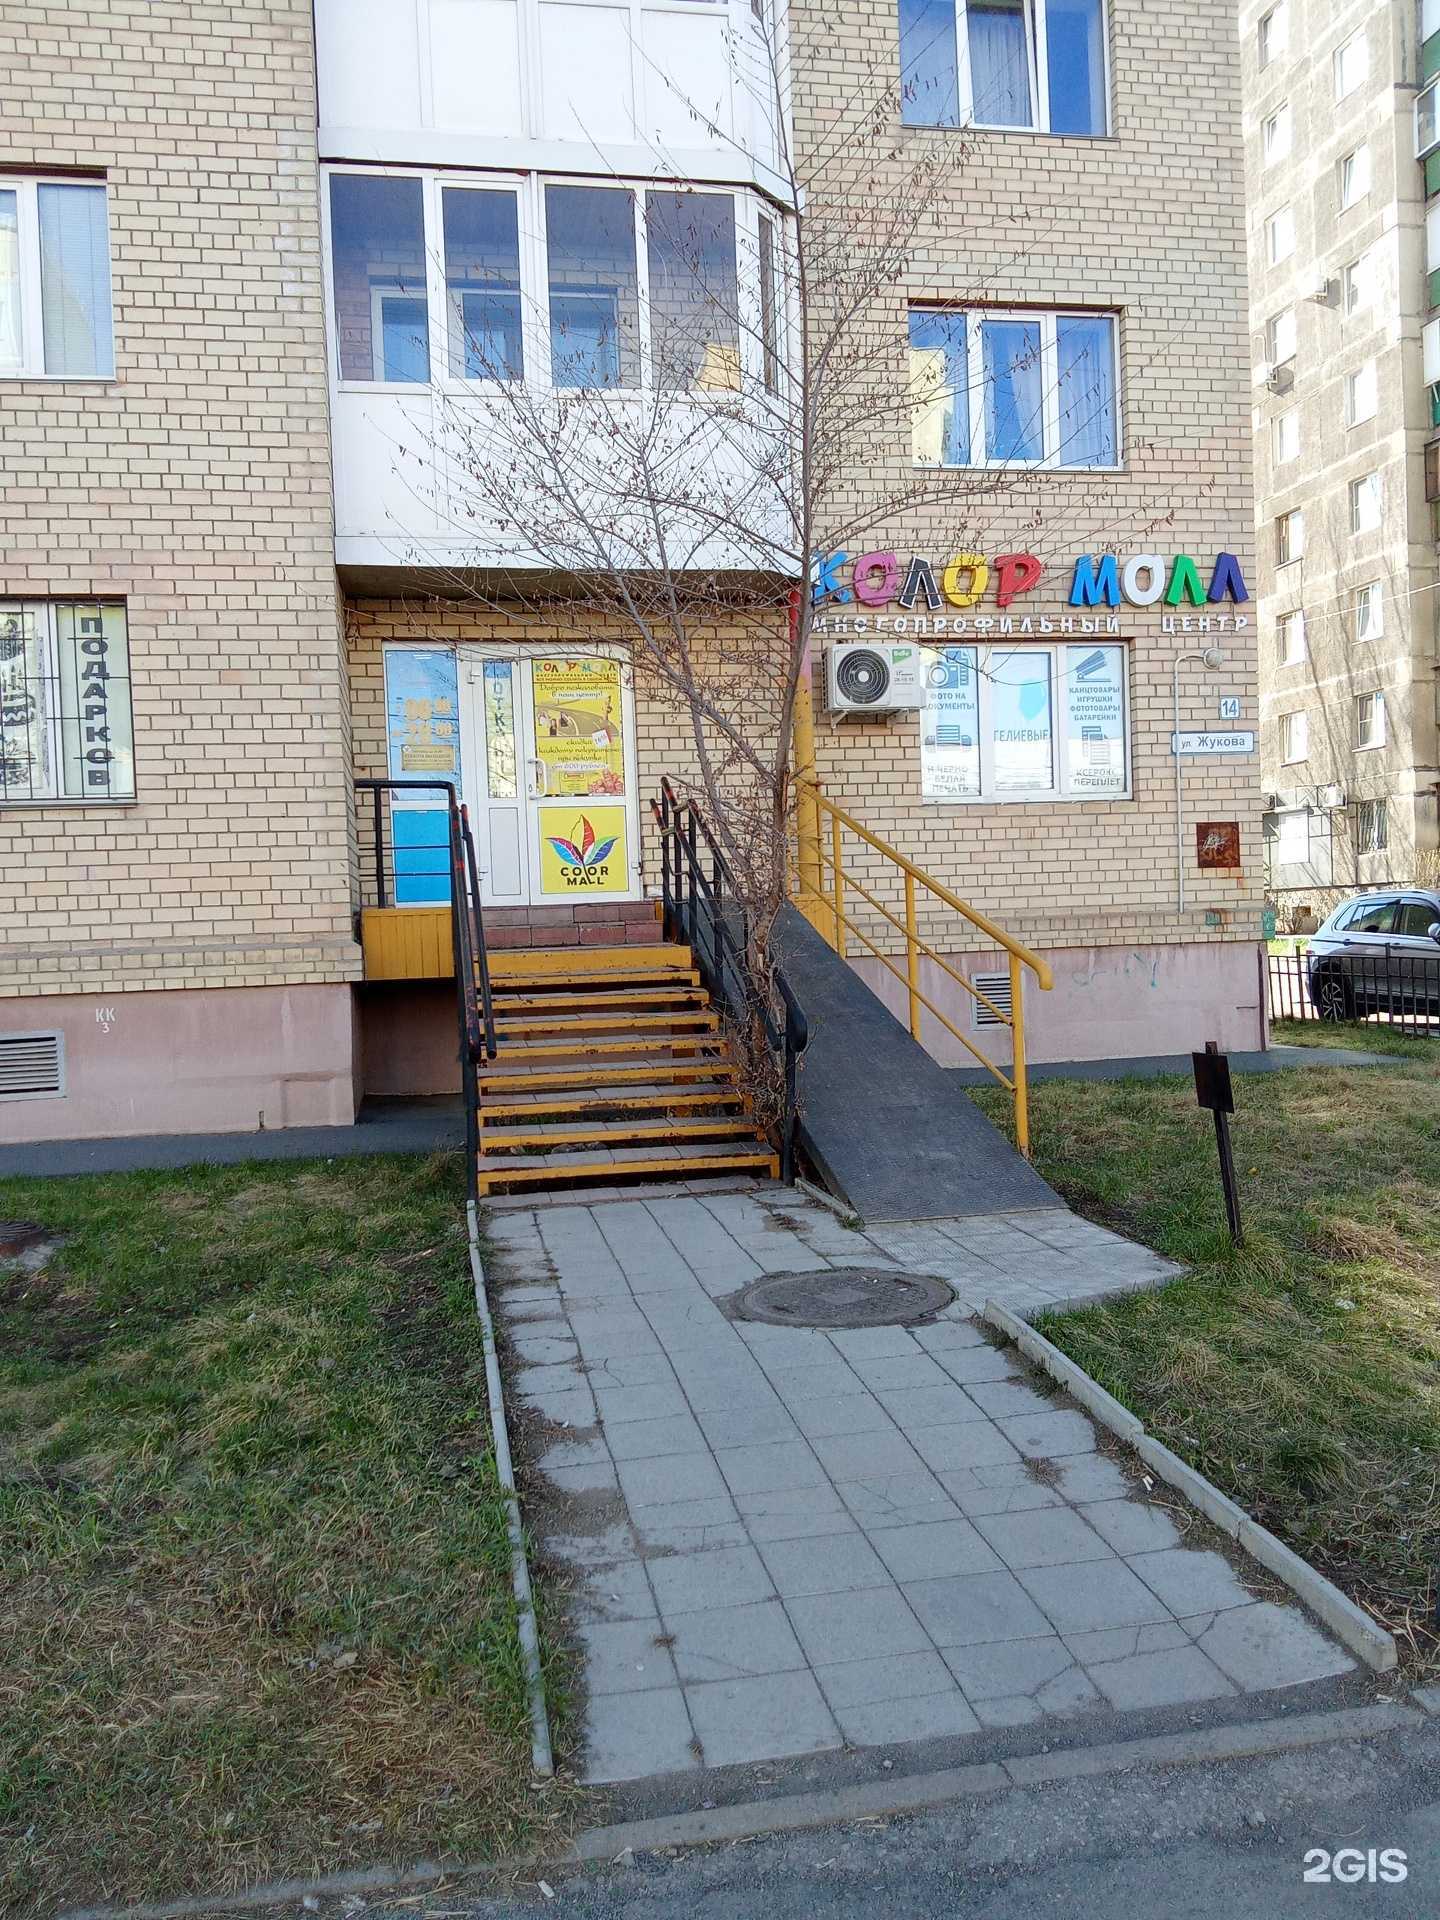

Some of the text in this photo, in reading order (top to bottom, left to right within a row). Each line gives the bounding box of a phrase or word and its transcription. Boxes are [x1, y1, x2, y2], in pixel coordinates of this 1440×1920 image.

[811, 551, 1249, 609] КОЛОР МОЛЛ
[811, 614, 1248, 634] МНОГОПРОФИЛЬНЫЙ ЦЕНТР
[81, 617, 112, 786] ПОДАРКОВ
[1222, 700, 1237, 716] 14
[993, 729, 1049, 742] ГЕЛИЕВЫЕ
[1198, 736, 1245, 749] Жукова
[566, 877, 605, 886] MALL
